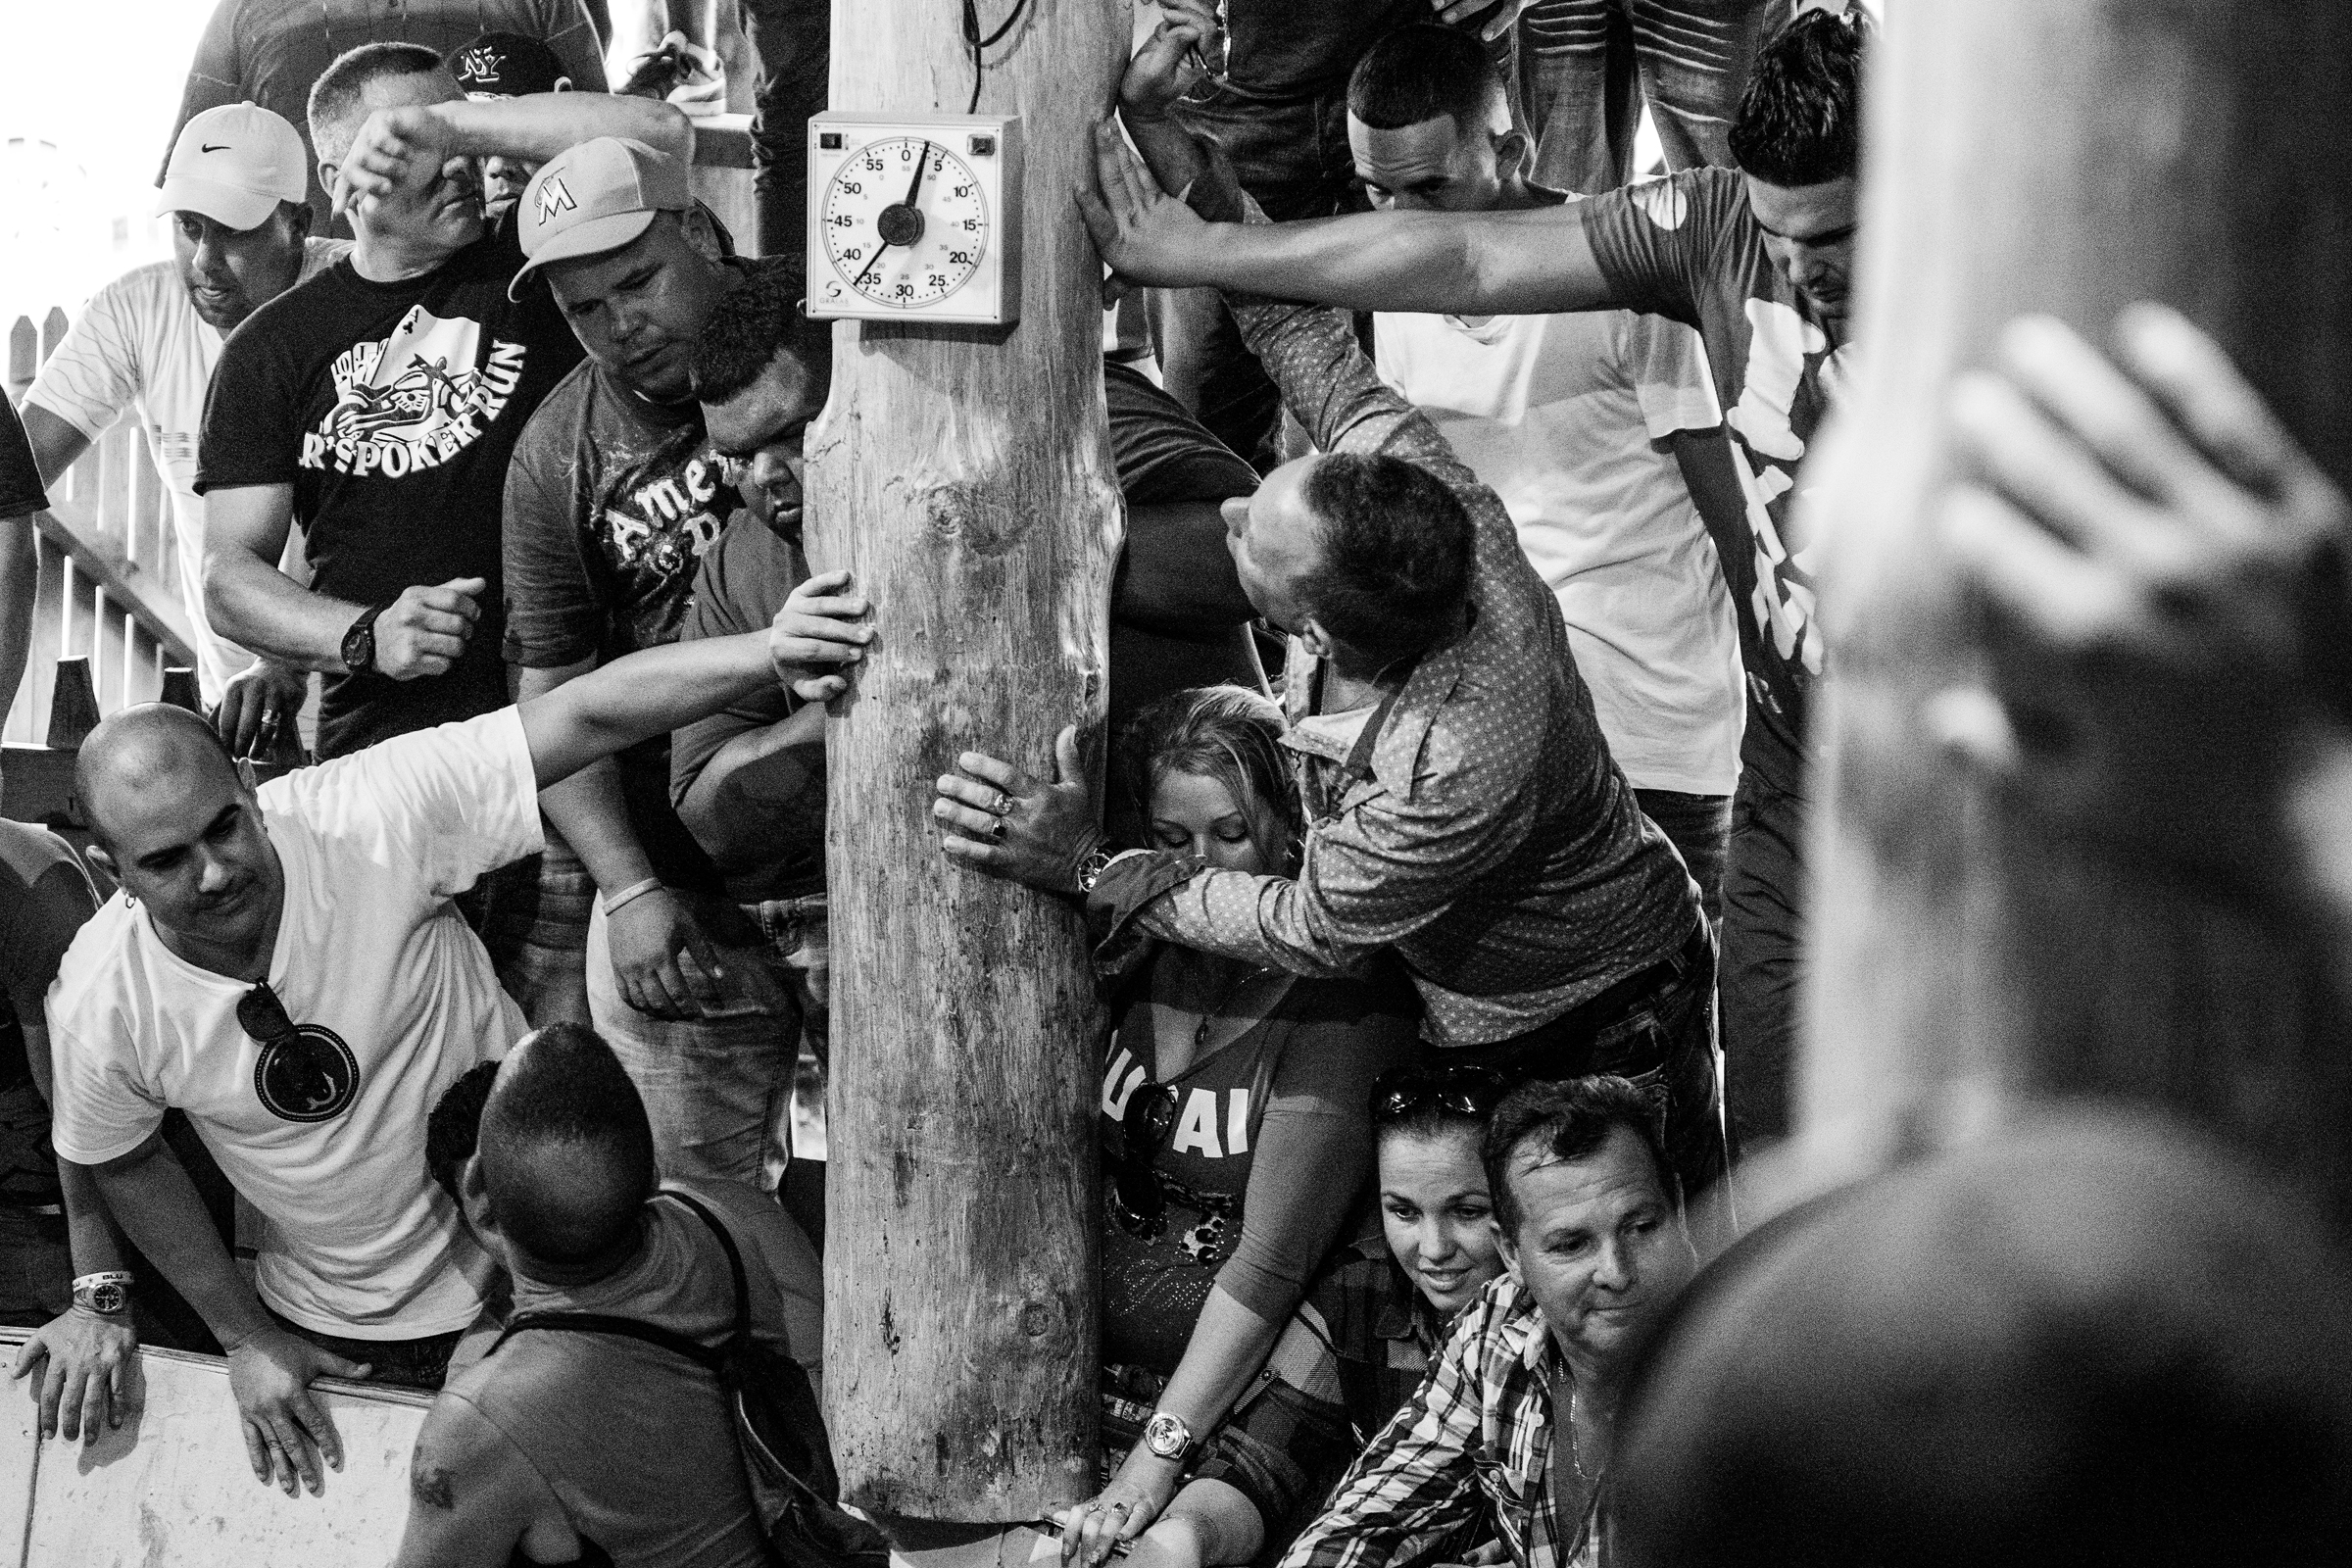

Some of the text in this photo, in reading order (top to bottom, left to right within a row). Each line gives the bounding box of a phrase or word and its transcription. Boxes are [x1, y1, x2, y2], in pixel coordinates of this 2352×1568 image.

[458, 46, 506, 82] NY
[902, 149, 910, 162] 0
[866, 159, 884, 171] 55
[934, 160, 943, 172] 5
[844, 182, 861, 194] 50
[954, 186, 968, 198] 10
[539, 178, 577, 226] M
[834, 215, 853, 227] 45
[962, 219, 976, 231] 15
[843, 248, 861, 261] 40
[949, 251, 967, 264] 20
[863, 272, 881, 284] 35
[929, 274, 946, 286] 25
[896, 284, 913, 297] 30
[352, 413, 483, 479] POKER
[468, 339, 526, 422] RUN
